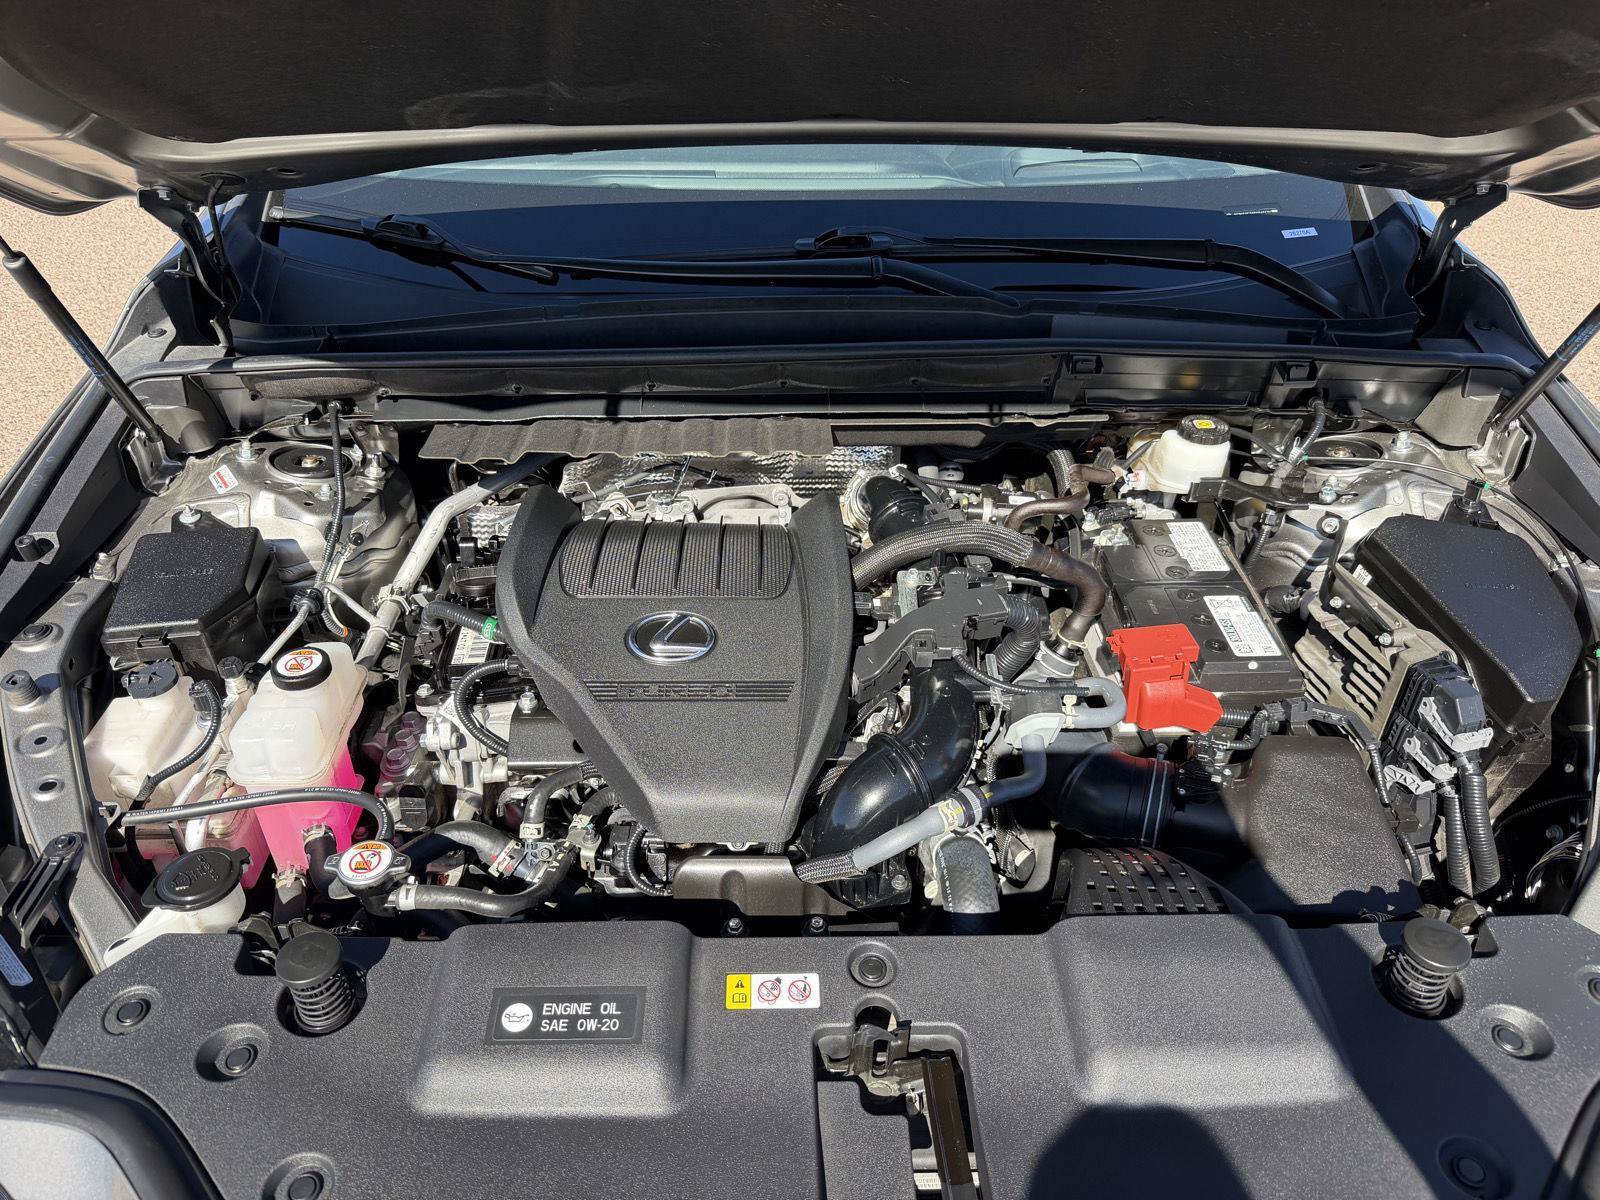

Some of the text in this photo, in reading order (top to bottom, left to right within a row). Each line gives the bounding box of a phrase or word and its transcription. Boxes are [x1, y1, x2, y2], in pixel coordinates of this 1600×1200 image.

[543, 1002, 622, 1015] ENGINE OIL
[540, 1018, 619, 1032] SAE 0W-20
